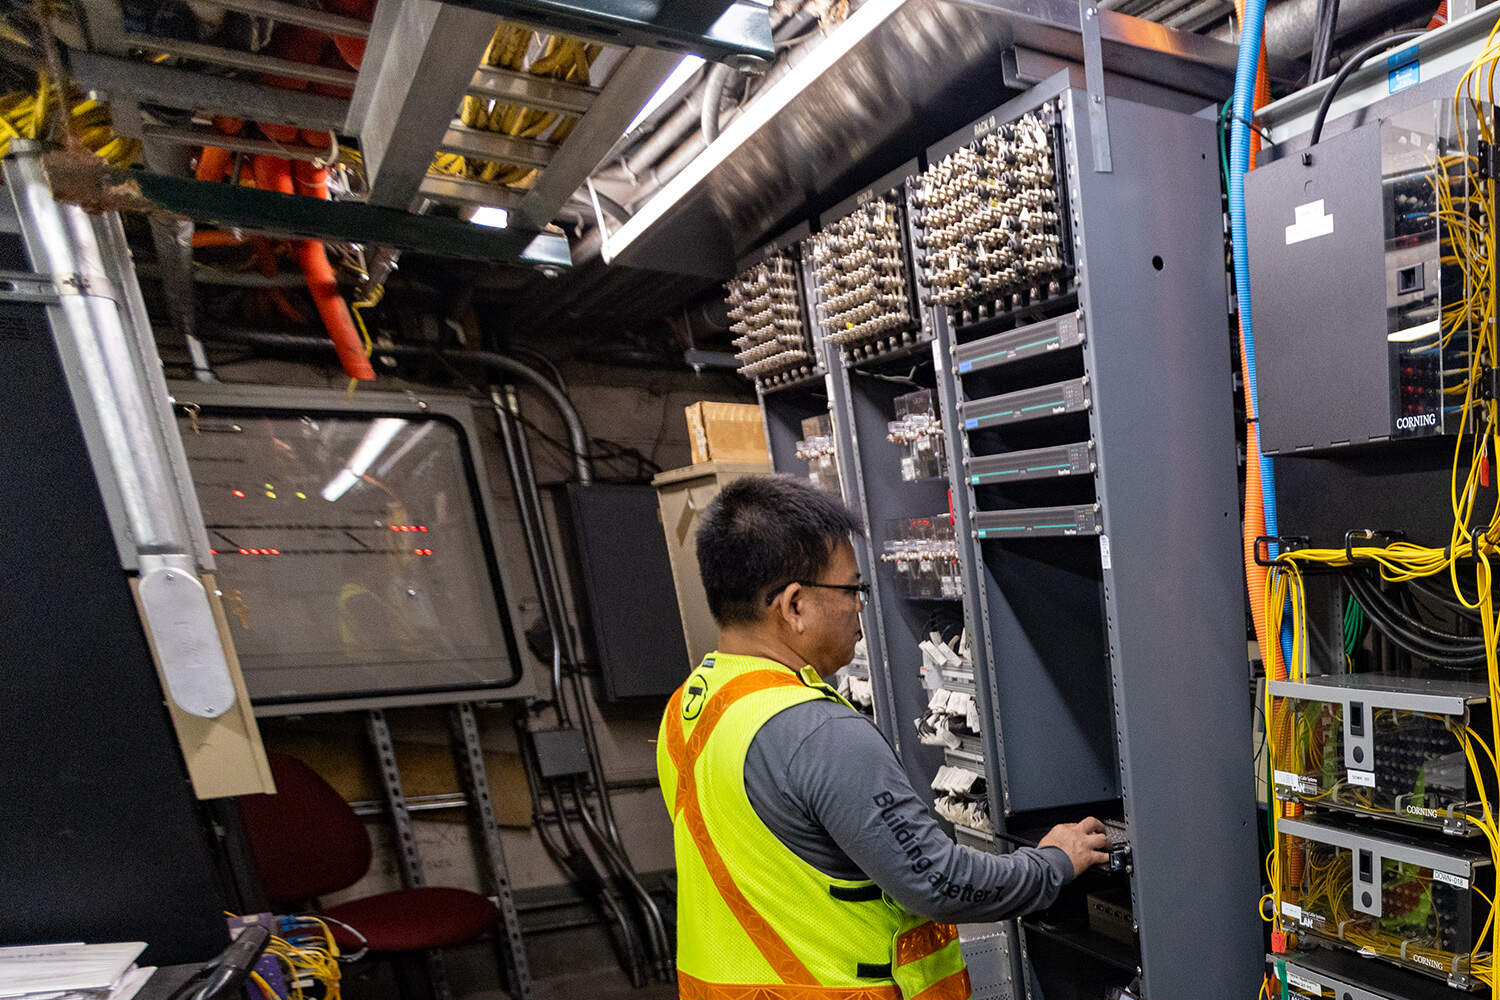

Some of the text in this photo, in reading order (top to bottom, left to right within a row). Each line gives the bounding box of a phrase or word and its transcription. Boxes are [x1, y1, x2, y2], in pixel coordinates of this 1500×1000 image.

[1396, 412, 1436, 430] CORNING
[1406, 804, 1438, 819] CORNING
[872, 790, 933, 874] Building
[1412, 953, 1444, 971] CORNING
